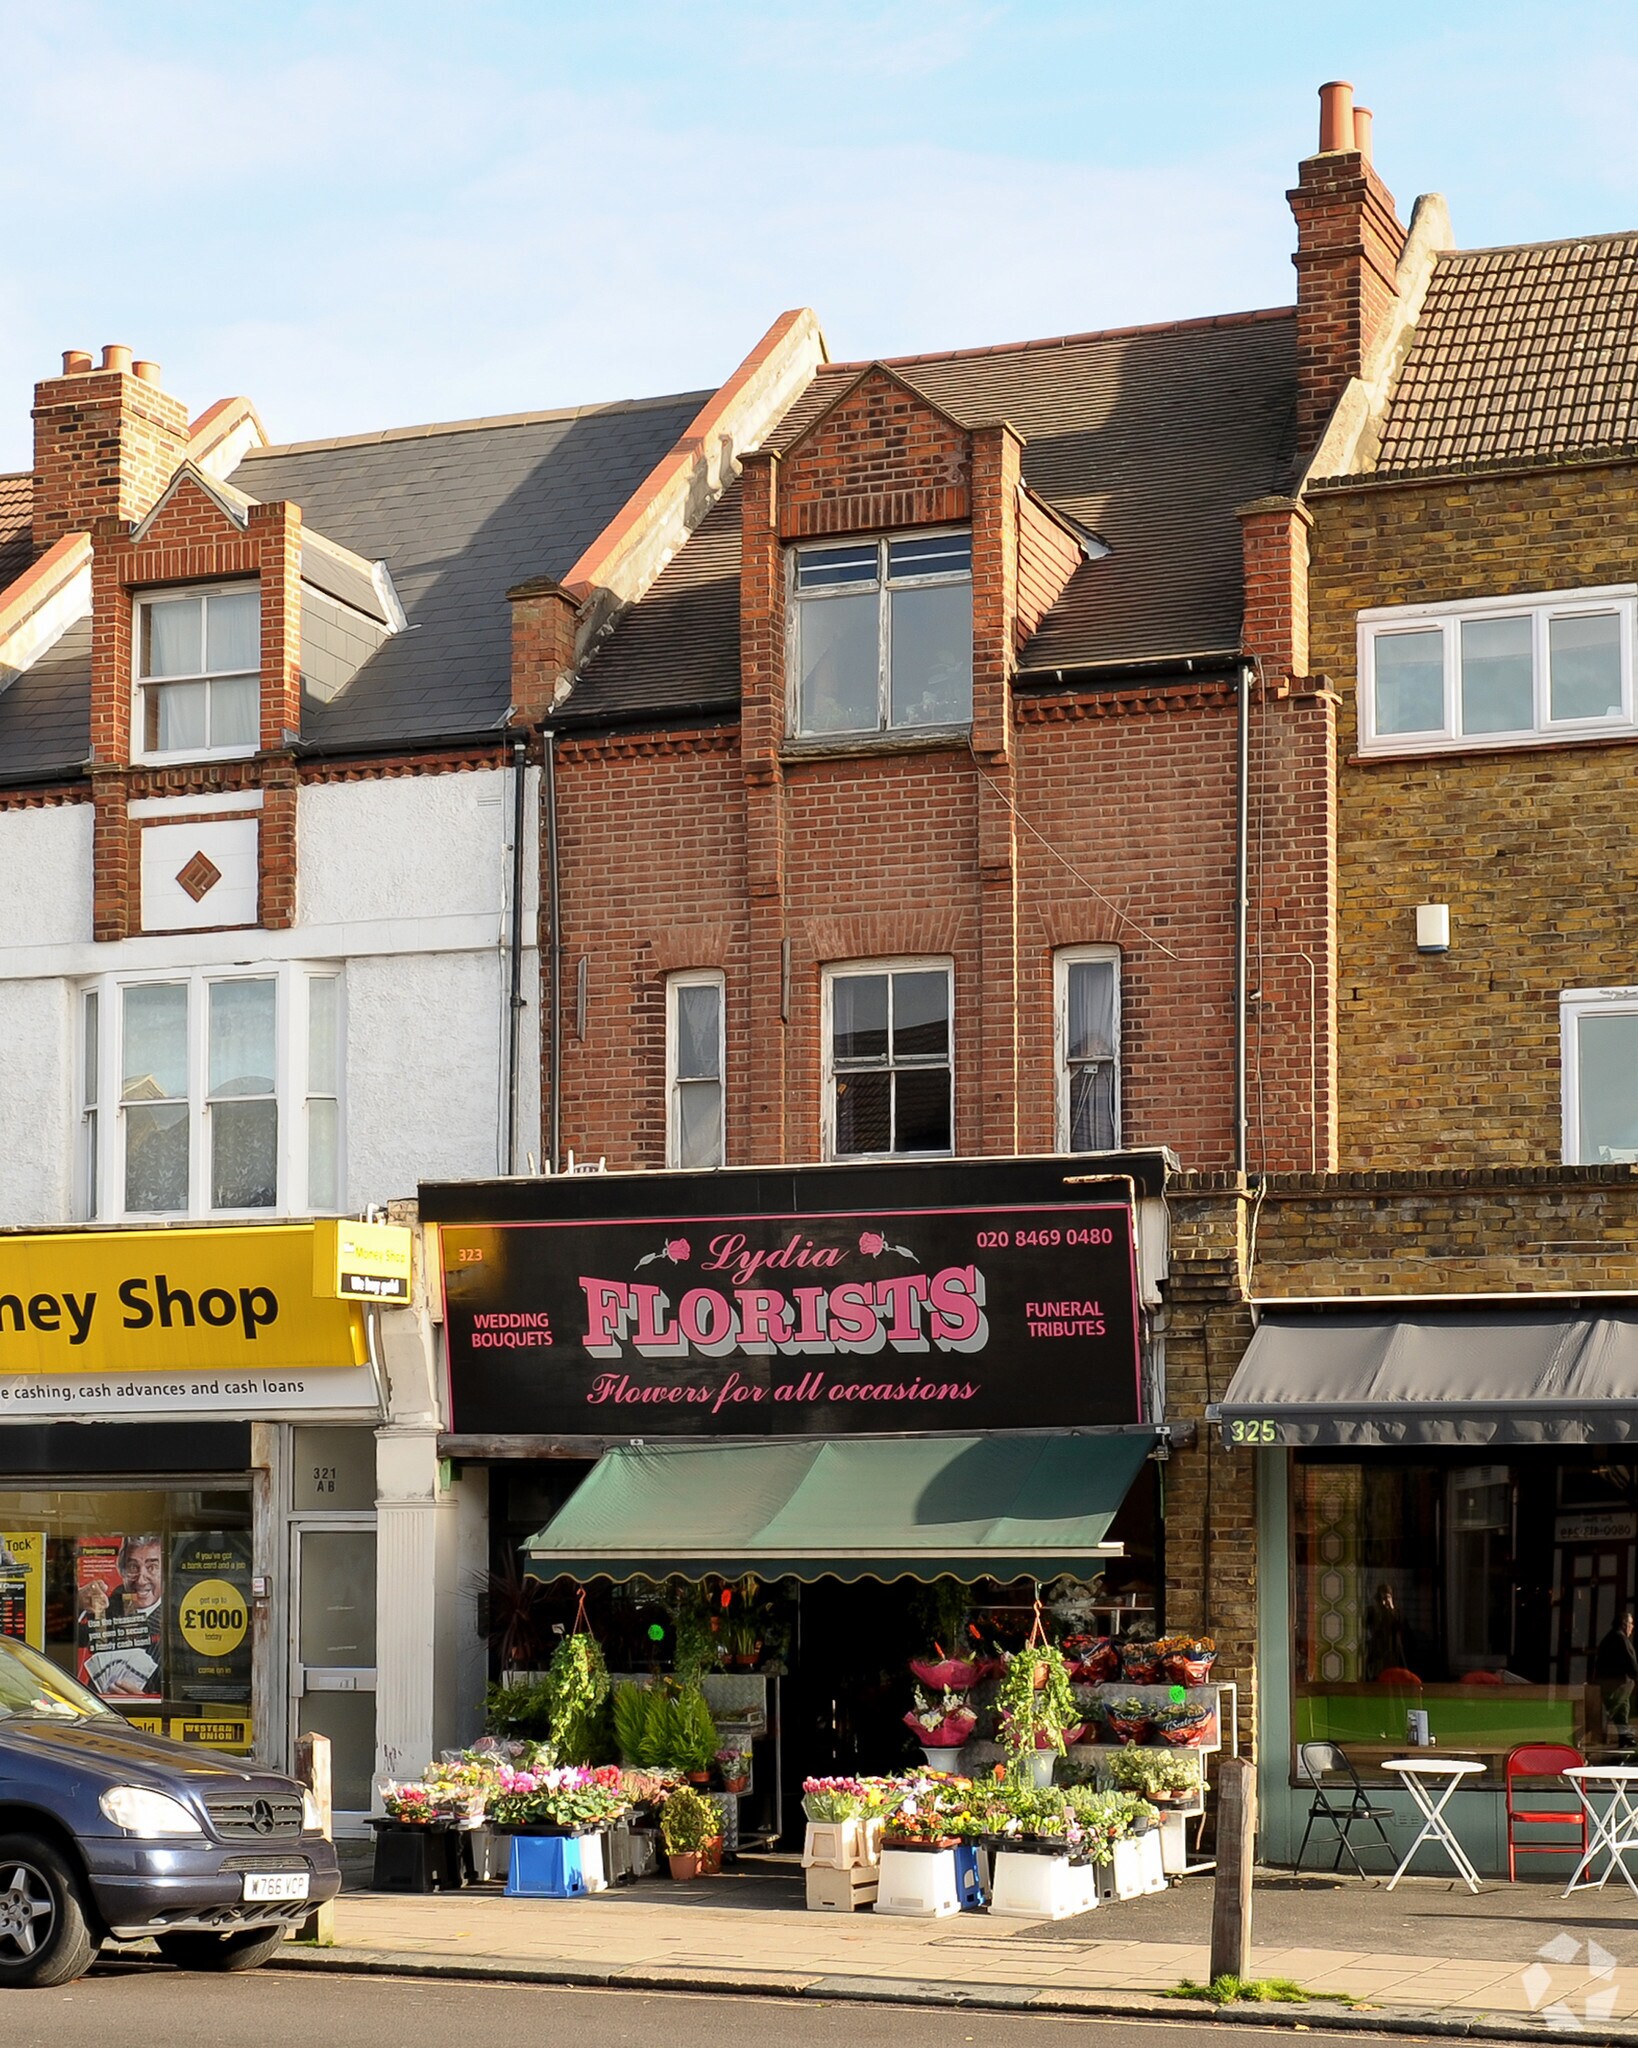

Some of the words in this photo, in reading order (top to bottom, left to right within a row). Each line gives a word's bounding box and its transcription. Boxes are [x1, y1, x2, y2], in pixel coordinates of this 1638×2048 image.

[976, 1231, 1009, 1247] 020
[1014, 1229, 1060, 1246] 8469
[1066, 1228, 1112, 1245] 0480
[459, 1249, 483, 1262] 323
[701, 1233, 849, 1285] Lydia
[118, 1275, 278, 1339] Shop
[578, 1264, 990, 1359] FLORISTS
[1026, 1302, 1103, 1317] FUNERAL
[474, 1312, 549, 1329] WEDDING
[1027, 1321, 1106, 1337] TRIBUTES
[472, 1332, 553, 1348] BOUQUETS
[14, 1385, 76, 1401] cashing,
[79, 1384, 111, 1398] cash
[117, 1382, 186, 1396] advances
[191, 1381, 219, 1395] and
[225, 1381, 258, 1394] cash
[263, 1379, 304, 1393] loans
[586, 1373, 714, 1405] Flowers
[711, 1373, 770, 1414] for
[774, 1372, 823, 1402] all
[828, 1377, 980, 1401] occasions
[1231, 1419, 1276, 1442] 325
[313, 1467, 336, 1479] 321
[316, 1480, 324, 1492] A
[328, 1480, 335, 1492] B
[6, 1539, 32, 1551] Tock
[184, 1609, 243, 1629] £1000
[205, 1632, 222, 1641] today
[184, 1724, 232, 1733] WESTERN
[199, 1732, 232, 1740] UNION
